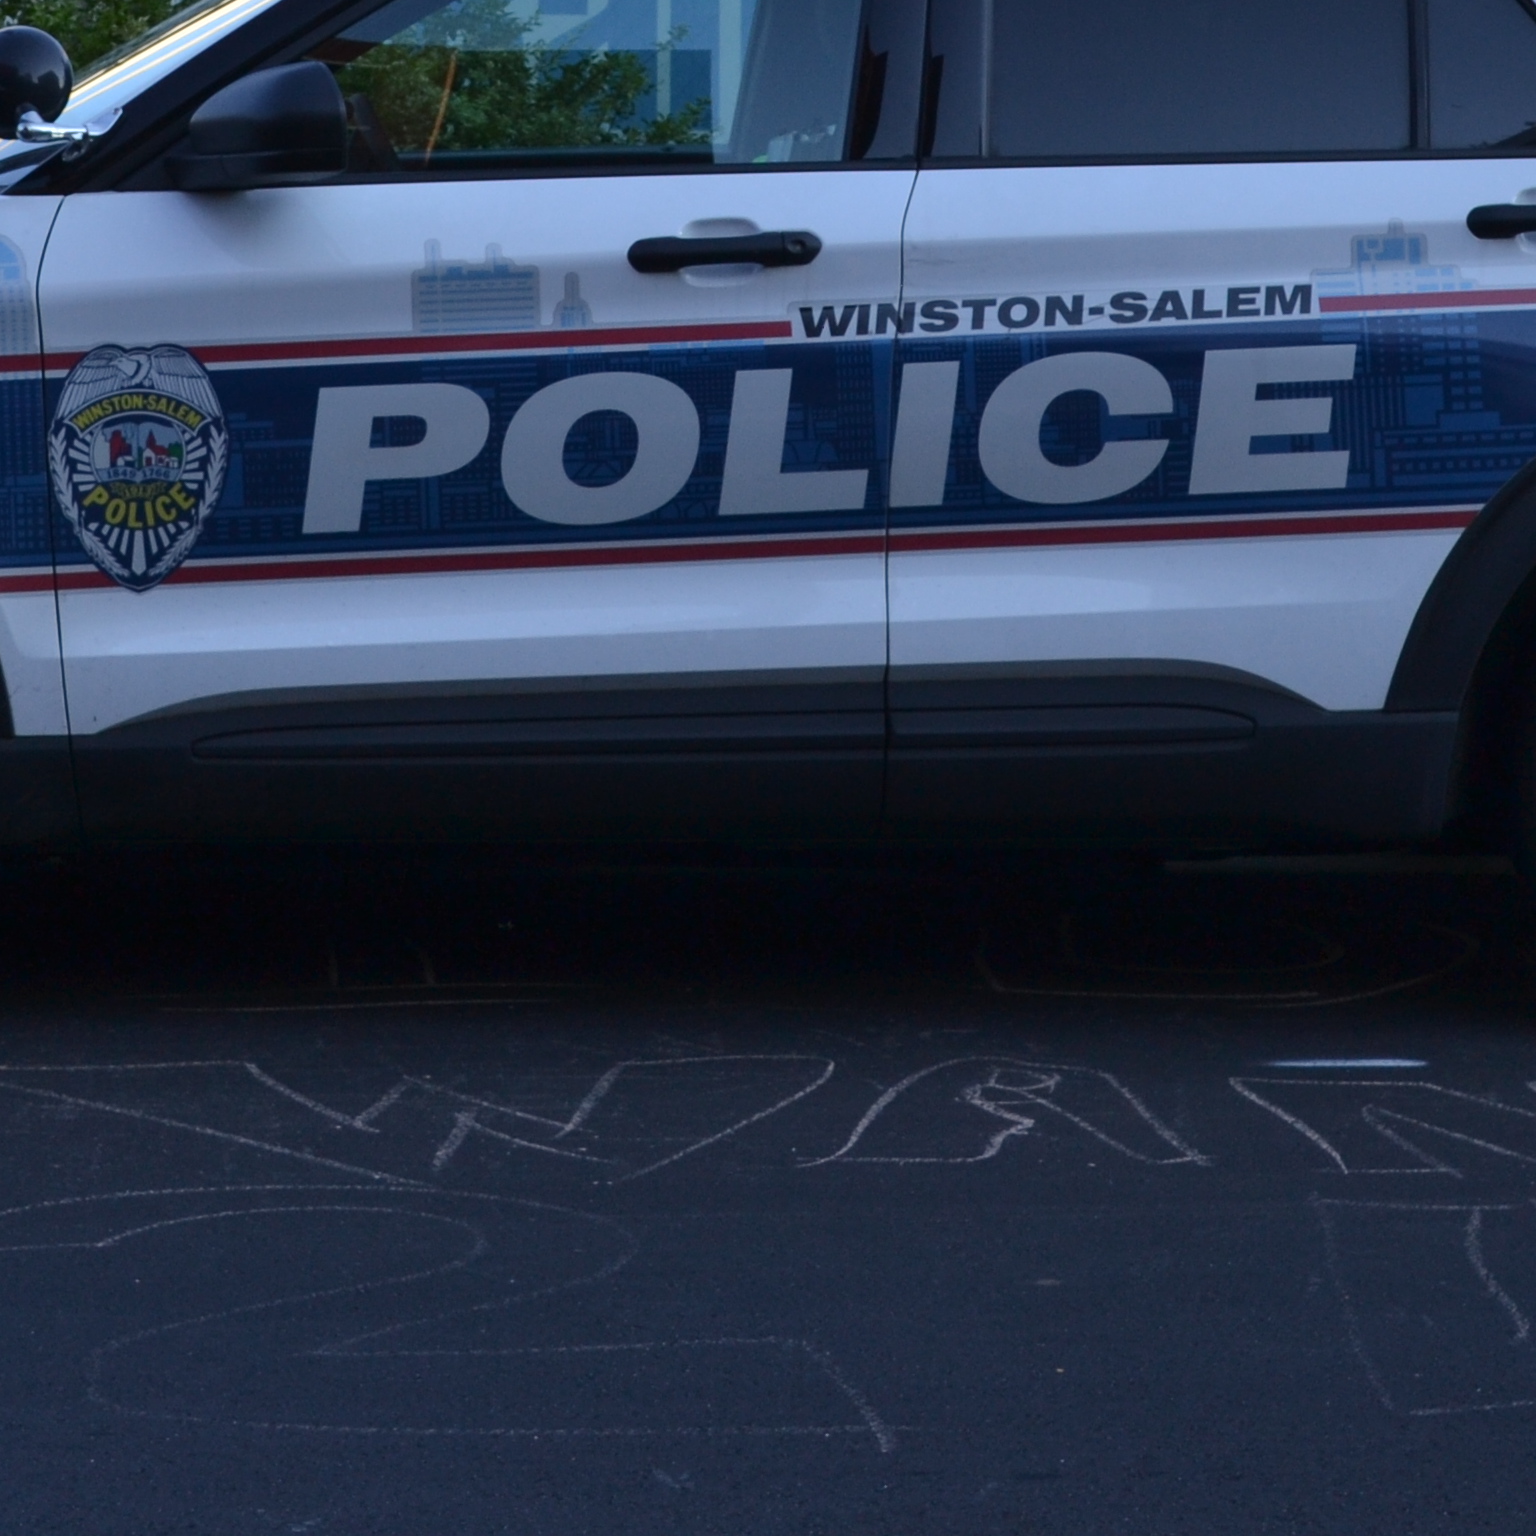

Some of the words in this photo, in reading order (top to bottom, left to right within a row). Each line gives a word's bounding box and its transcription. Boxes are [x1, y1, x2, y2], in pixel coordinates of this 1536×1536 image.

[797, 283, 1313, 339] WINSTON-SALEM
[300, 343, 1358, 535] POLICE
[83, 482, 195, 528] POLICE
